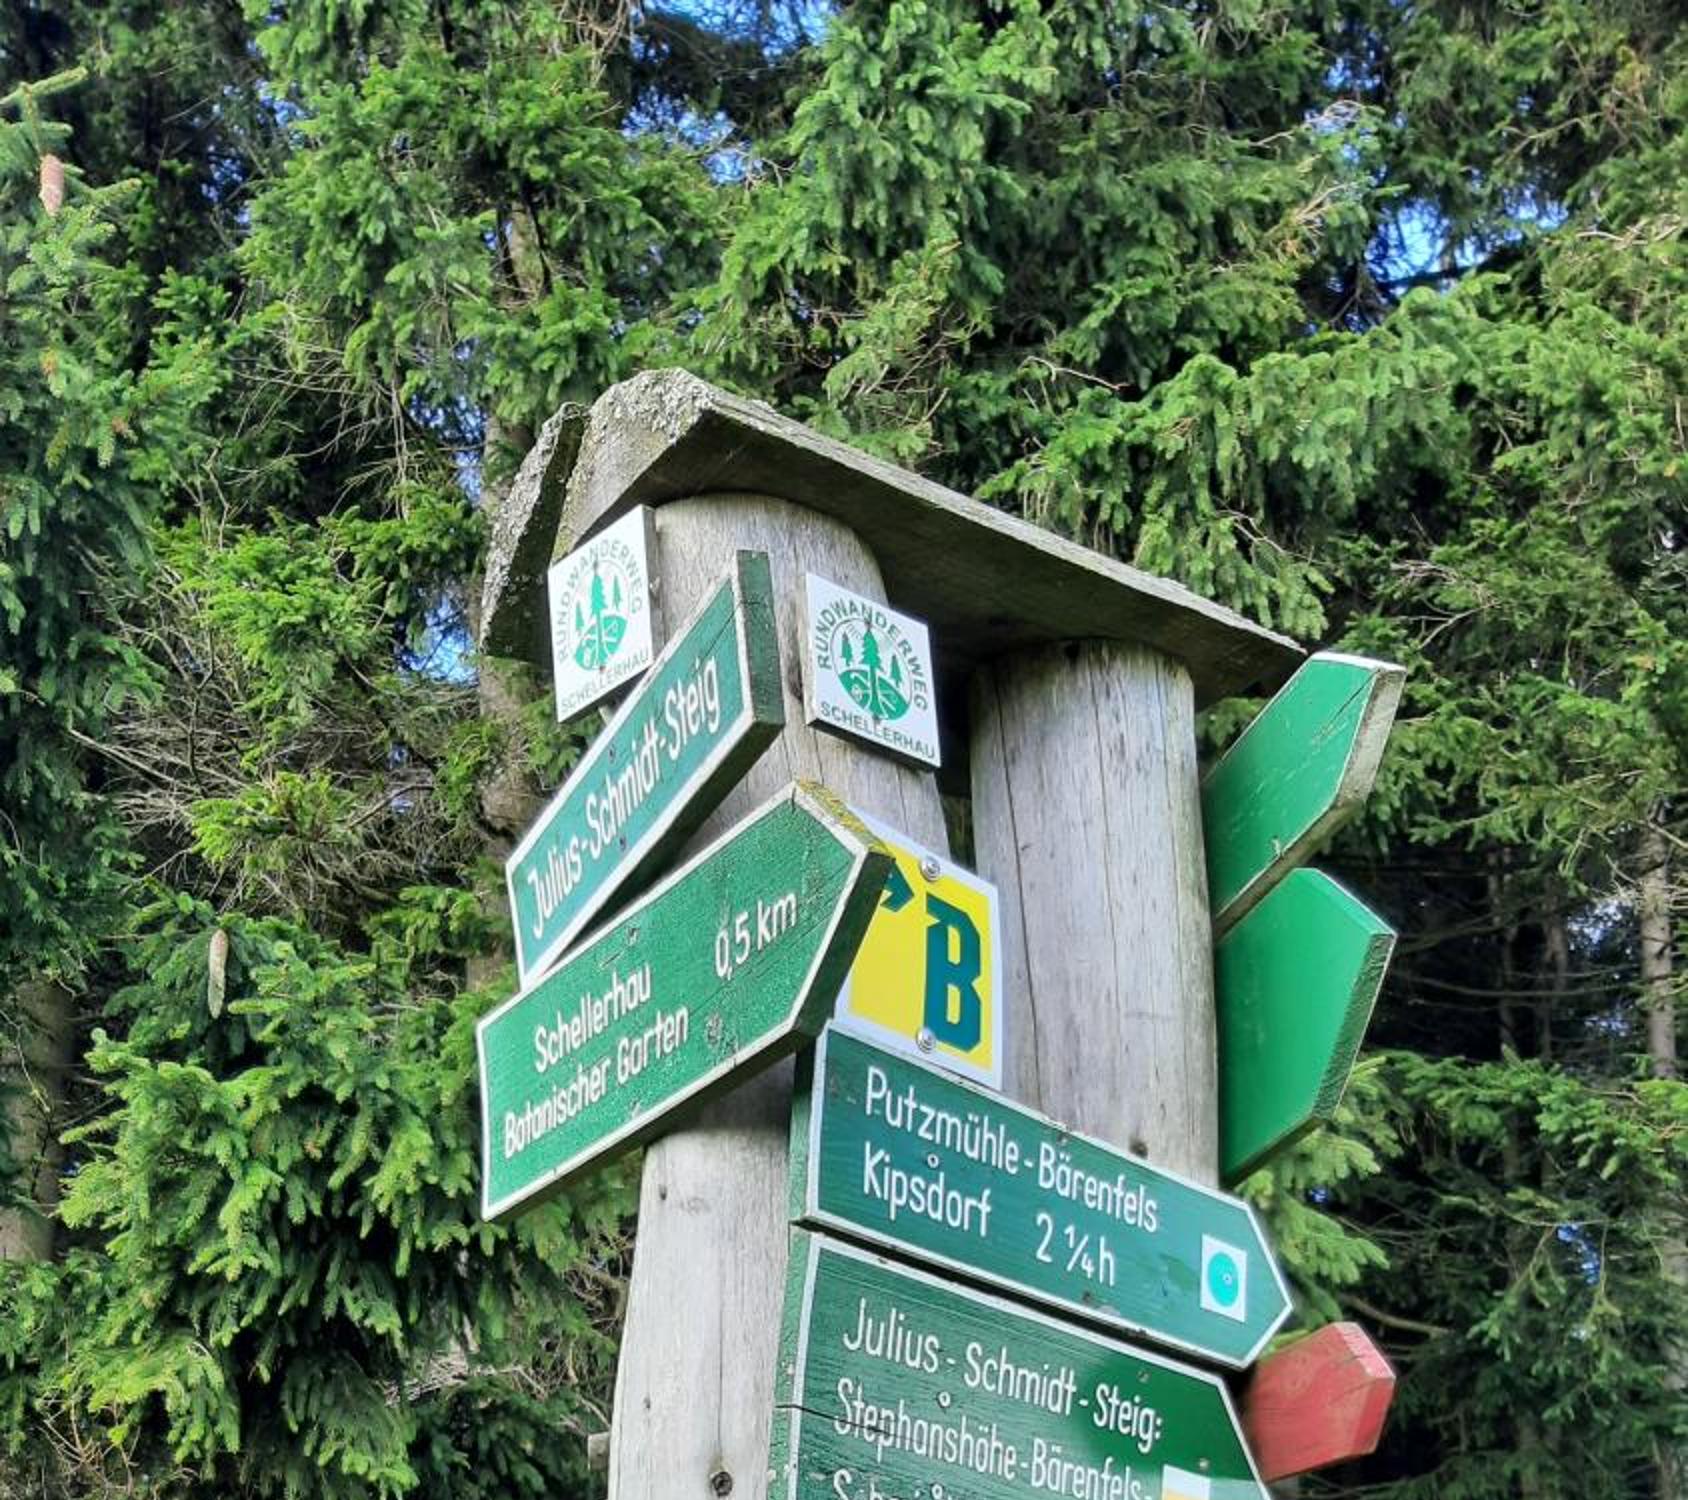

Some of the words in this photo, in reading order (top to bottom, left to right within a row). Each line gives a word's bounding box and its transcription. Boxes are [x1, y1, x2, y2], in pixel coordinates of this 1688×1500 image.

[561, 650, 648, 712] SCHELLERHAU
[816, 598, 928, 711] RUNDWANDERWEG
[821, 701, 935, 759] SCHELLERHAU
[715, 912, 751, 980] 0,5
[757, 892, 797, 950] km
[535, 964, 650, 1072] Schellerhau
[505, 1056, 611, 1159] Botanischer
[617, 1005, 688, 1084] Garten
[863, 1141, 992, 1237] Kipsdorf
